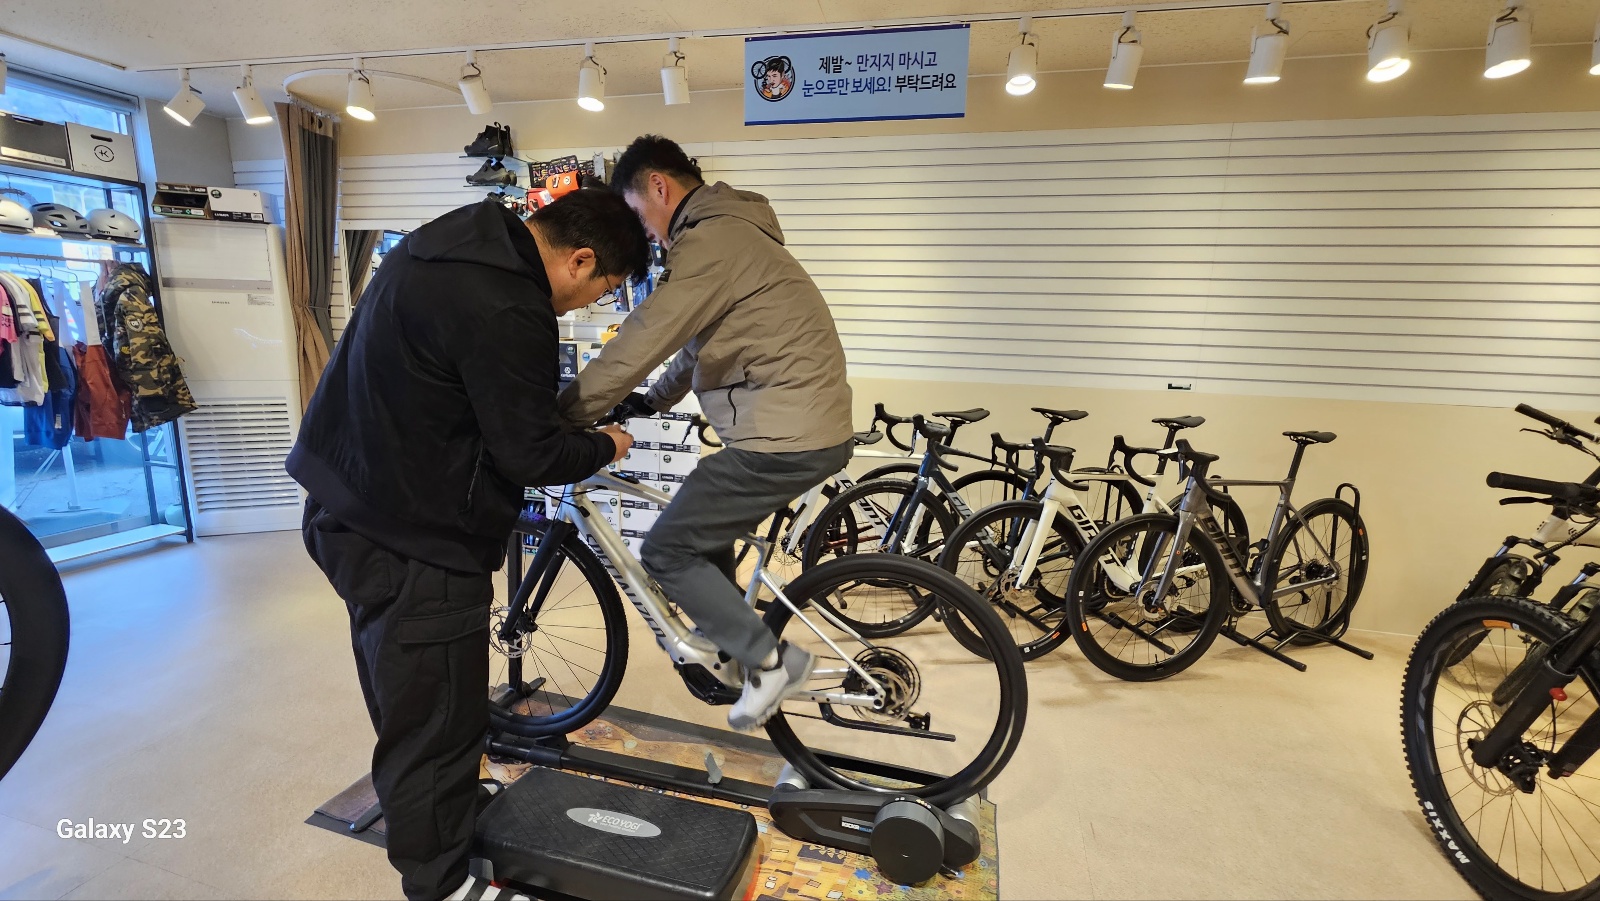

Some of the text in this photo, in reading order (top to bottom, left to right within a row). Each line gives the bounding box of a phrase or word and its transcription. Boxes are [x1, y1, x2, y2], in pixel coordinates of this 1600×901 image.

[818, 51, 937, 74] 제발~ 만지지 마시고
[801, 73, 957, 97] 눈으로만 보세요! 부탁드려요
[620, 819, 641, 831] YOGI
[1423, 800, 1471, 864] MAXXIS
